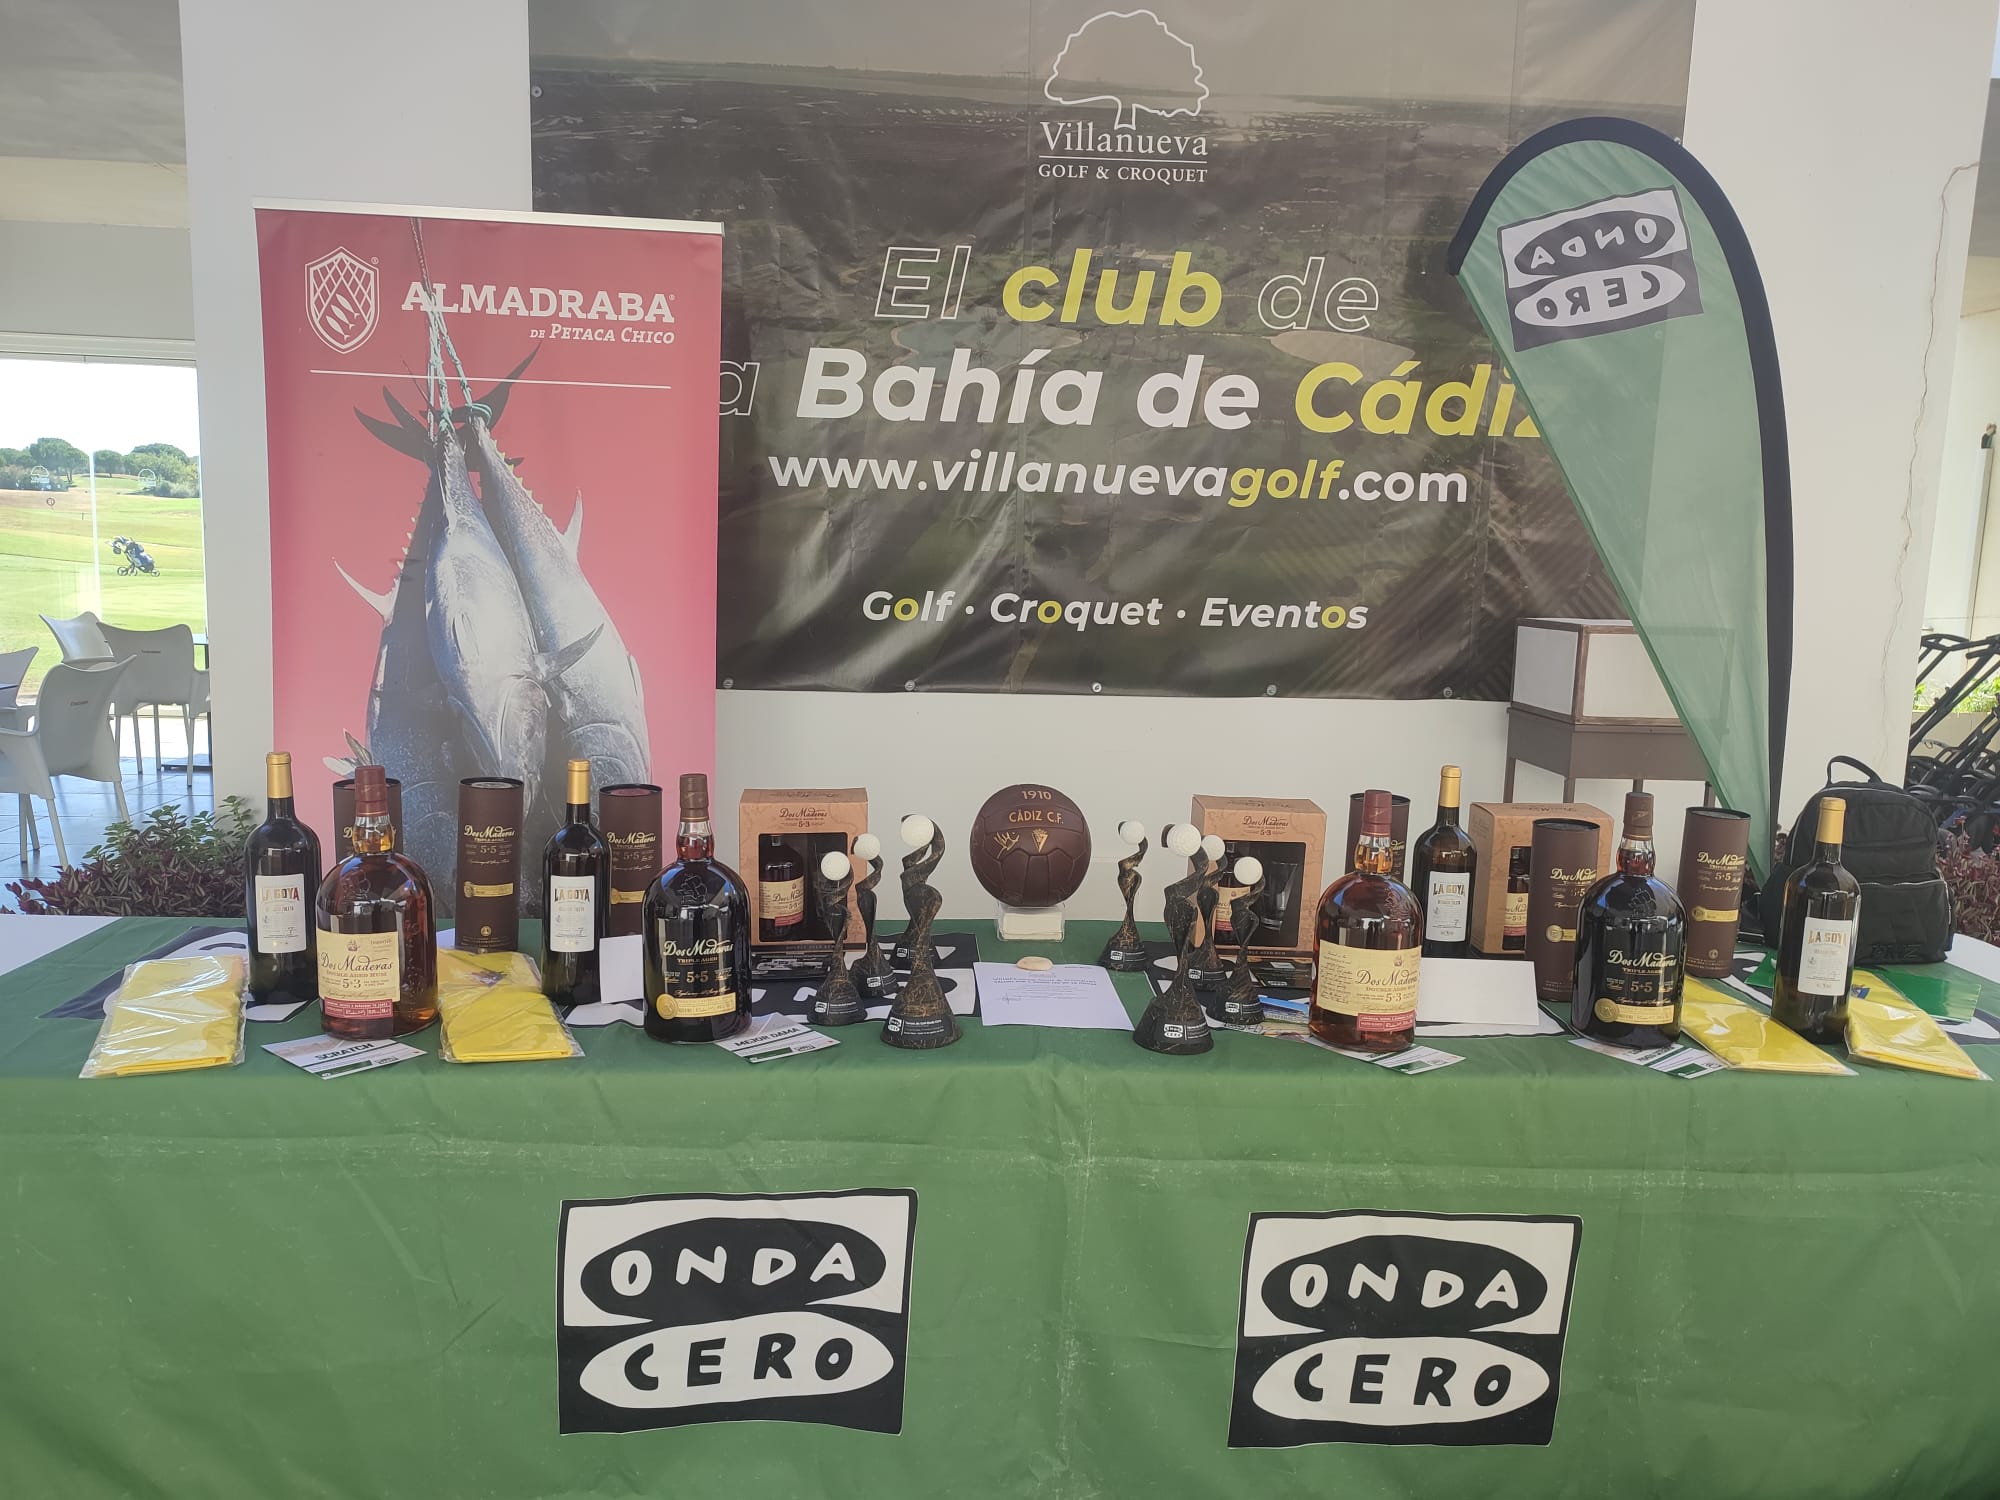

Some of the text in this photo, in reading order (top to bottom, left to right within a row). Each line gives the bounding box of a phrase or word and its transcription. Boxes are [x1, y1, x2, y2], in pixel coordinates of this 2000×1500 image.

[1040, 121, 1208, 156] Villanueva
[1038, 163, 1208, 186] GOLF & CROQUET
[874, 245, 1379, 333] El club de
[796, 347, 1103, 426] Bahía
[1136, 354, 1260, 430] de
[768, 448, 1468, 507] www.villanuevagolf.com
[862, 590, 1369, 631] Golf Croquet Eventos
[1022, 790, 1052, 800] 1910
[321, 951, 394, 972] Dos Maderas
[663, 938, 734, 957] Dos Maderas
[1607, 949, 1633, 966] Dos
[1633, 951, 1678, 967] Maderas
[1355, 969, 1381, 986] Dos
[314, 1042, 376, 1060] SCRATCH
[610, 1242, 856, 1297] ONDA
[1289, 1263, 1519, 1309] ONDA
[623, 1332, 853, 1391] CERO
[1294, 1352, 1511, 1406] CERO
